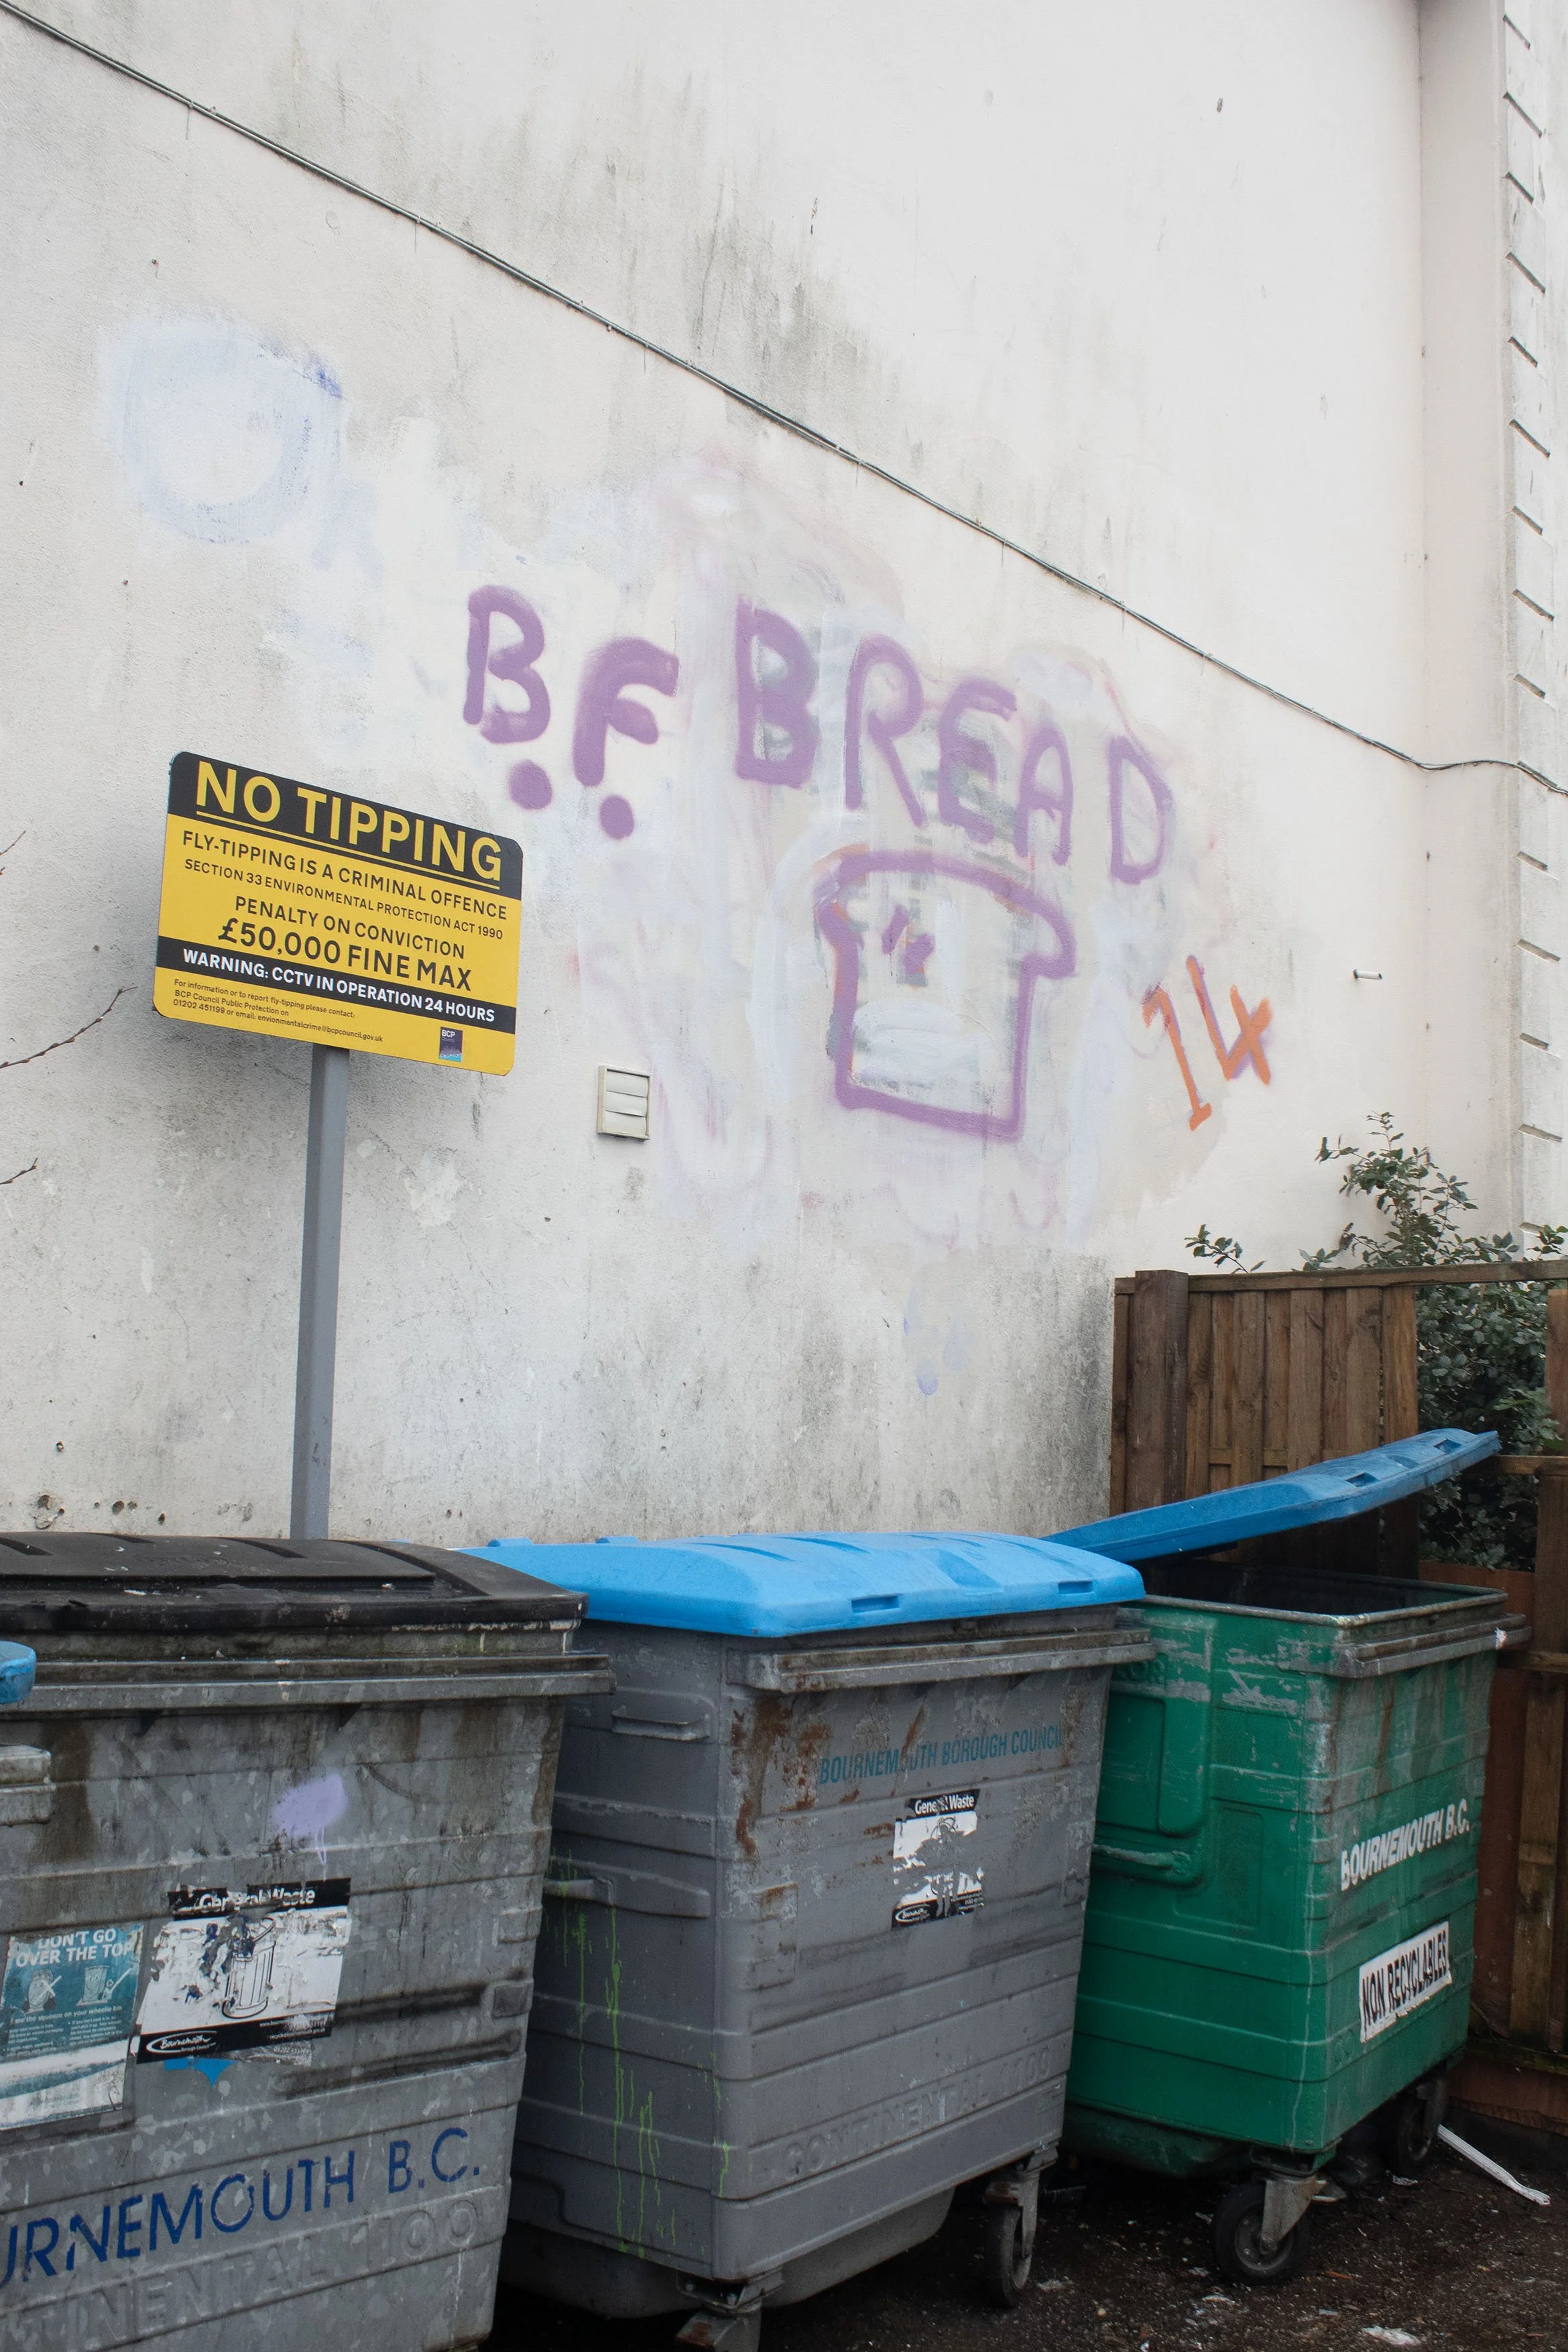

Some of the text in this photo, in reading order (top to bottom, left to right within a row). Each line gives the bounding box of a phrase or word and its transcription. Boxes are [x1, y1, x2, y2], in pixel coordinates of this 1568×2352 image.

[735, 594, 1174, 886] BREAD
[196, 760, 501, 882] NO TIPPING
[182, 830, 507, 921] FLY-TIPPING IS A CRIMINAL OFFENCE
[184, 858, 503, 940] SECTION 33 ENVIRONMENTAL PROTECTION ACT 1990
[217, 917, 472, 992] £50,000 FINE MAX
[235, 895, 465, 959] PENALTY ON CONVICTION
[173, 999, 197, 1009] 01202
[199, 1003, 225, 1014] 451199
[235, 1011, 256, 1020] email:
[174, 979, 186, 987] For
[187, 980, 229, 995] information
[247, 994, 269, 1004] report
[270, 996, 305, 1010] fly-tipping
[306, 1004, 327, 1014] please
[328, 1008, 355, 1018] contact:
[174, 990, 192, 998] BCP
[192, 993, 219, 1004] Council
[221, 998, 243, 1008] Public
[244, 1002, 279, 1014] Protection
[183, 948, 495, 1022] WARNING: CCTV IN OPERATION 24 HOURS
[442, 1029, 456, 1038] BCP
[1142, 955, 1274, 1131] 14
[941, 1733, 1007, 1767] BOROUGH
[914, 1794, 975, 1815] Genel Waste
[1341, 1798, 1470, 1891] BOURNEMOUTH B.C.
[15, 1950, 61, 1967] OVER
[67, 1945, 97, 1962] THE
[93, 1928, 117, 1944] GO
[1362, 1930, 1448, 2027] NON RECYCLABLES
[387, 2127, 481, 2193] B.C.
